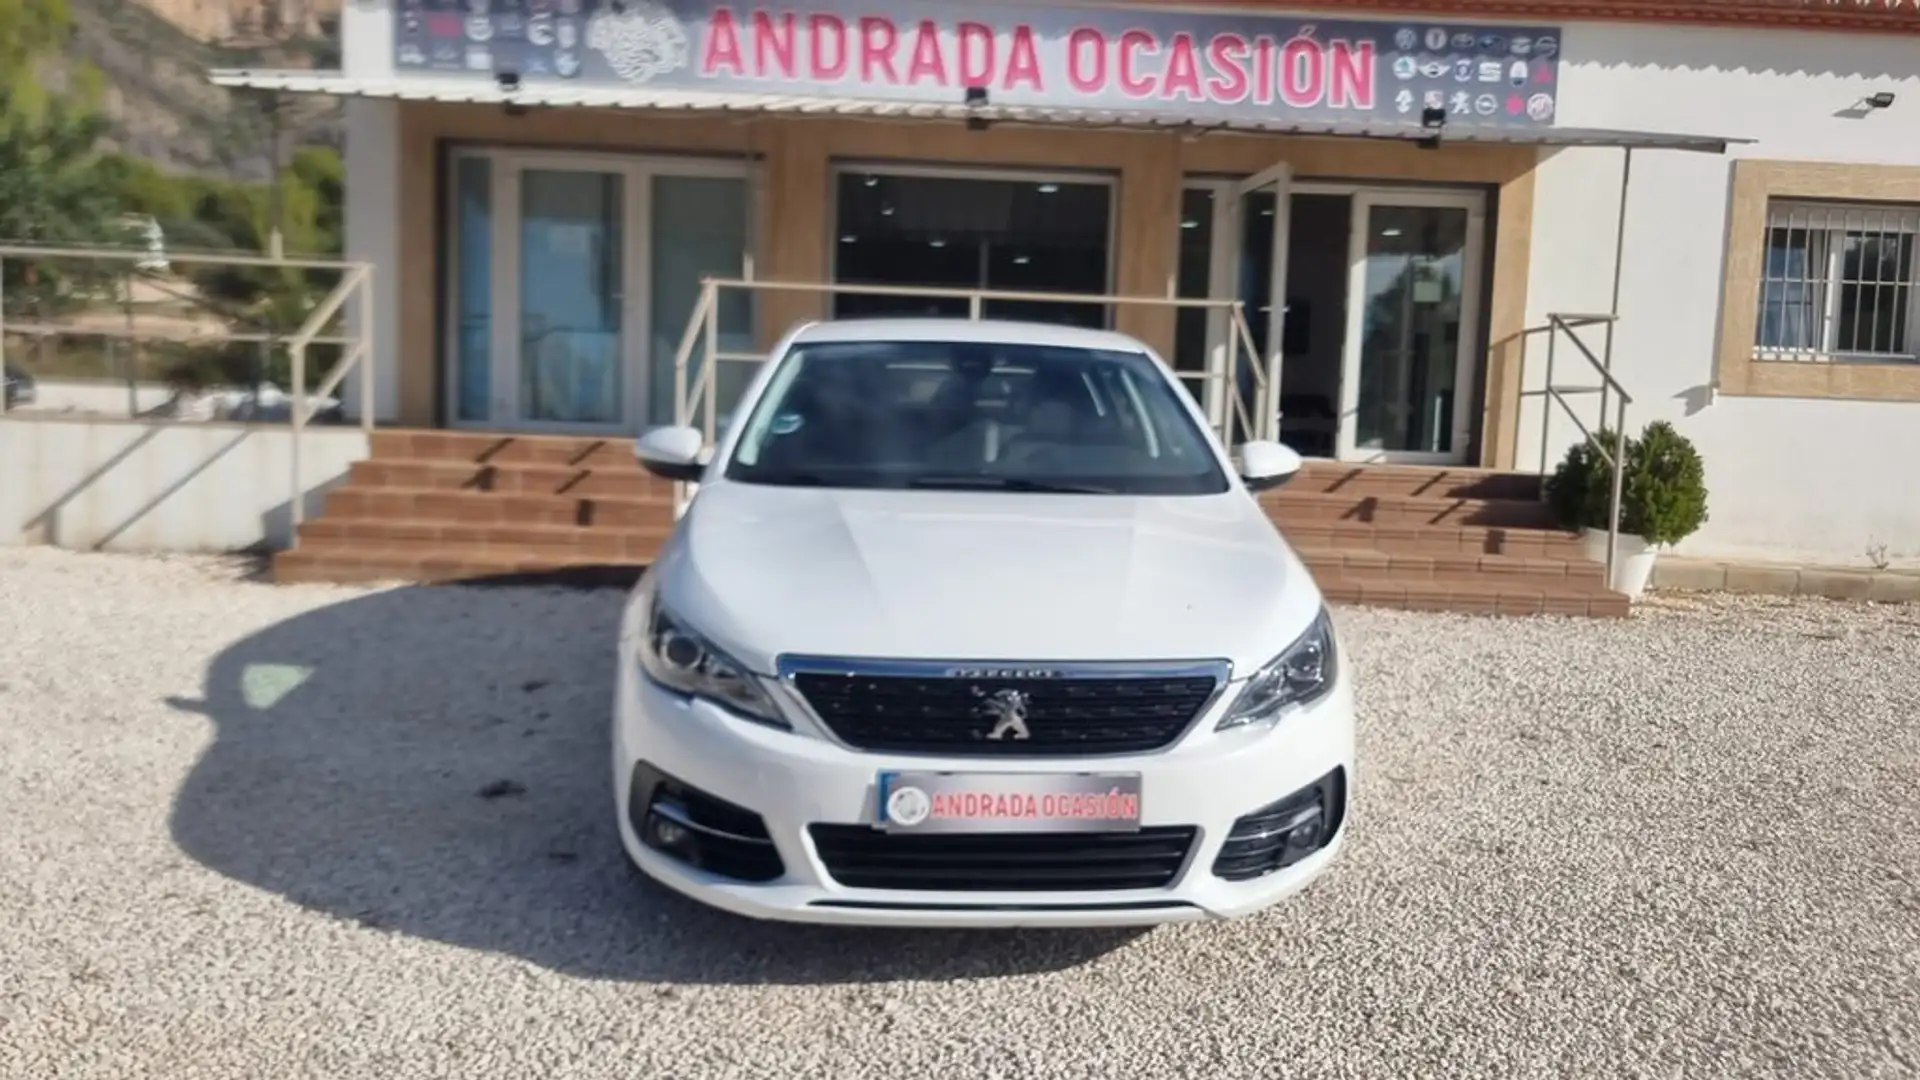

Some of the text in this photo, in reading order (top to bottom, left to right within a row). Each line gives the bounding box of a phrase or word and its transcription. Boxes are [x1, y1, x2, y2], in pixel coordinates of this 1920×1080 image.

[703, 8, 1376, 109] ANDRADA OCASIÓN
[932, 786, 1138, 819] ANDRADA OCASIÓN
